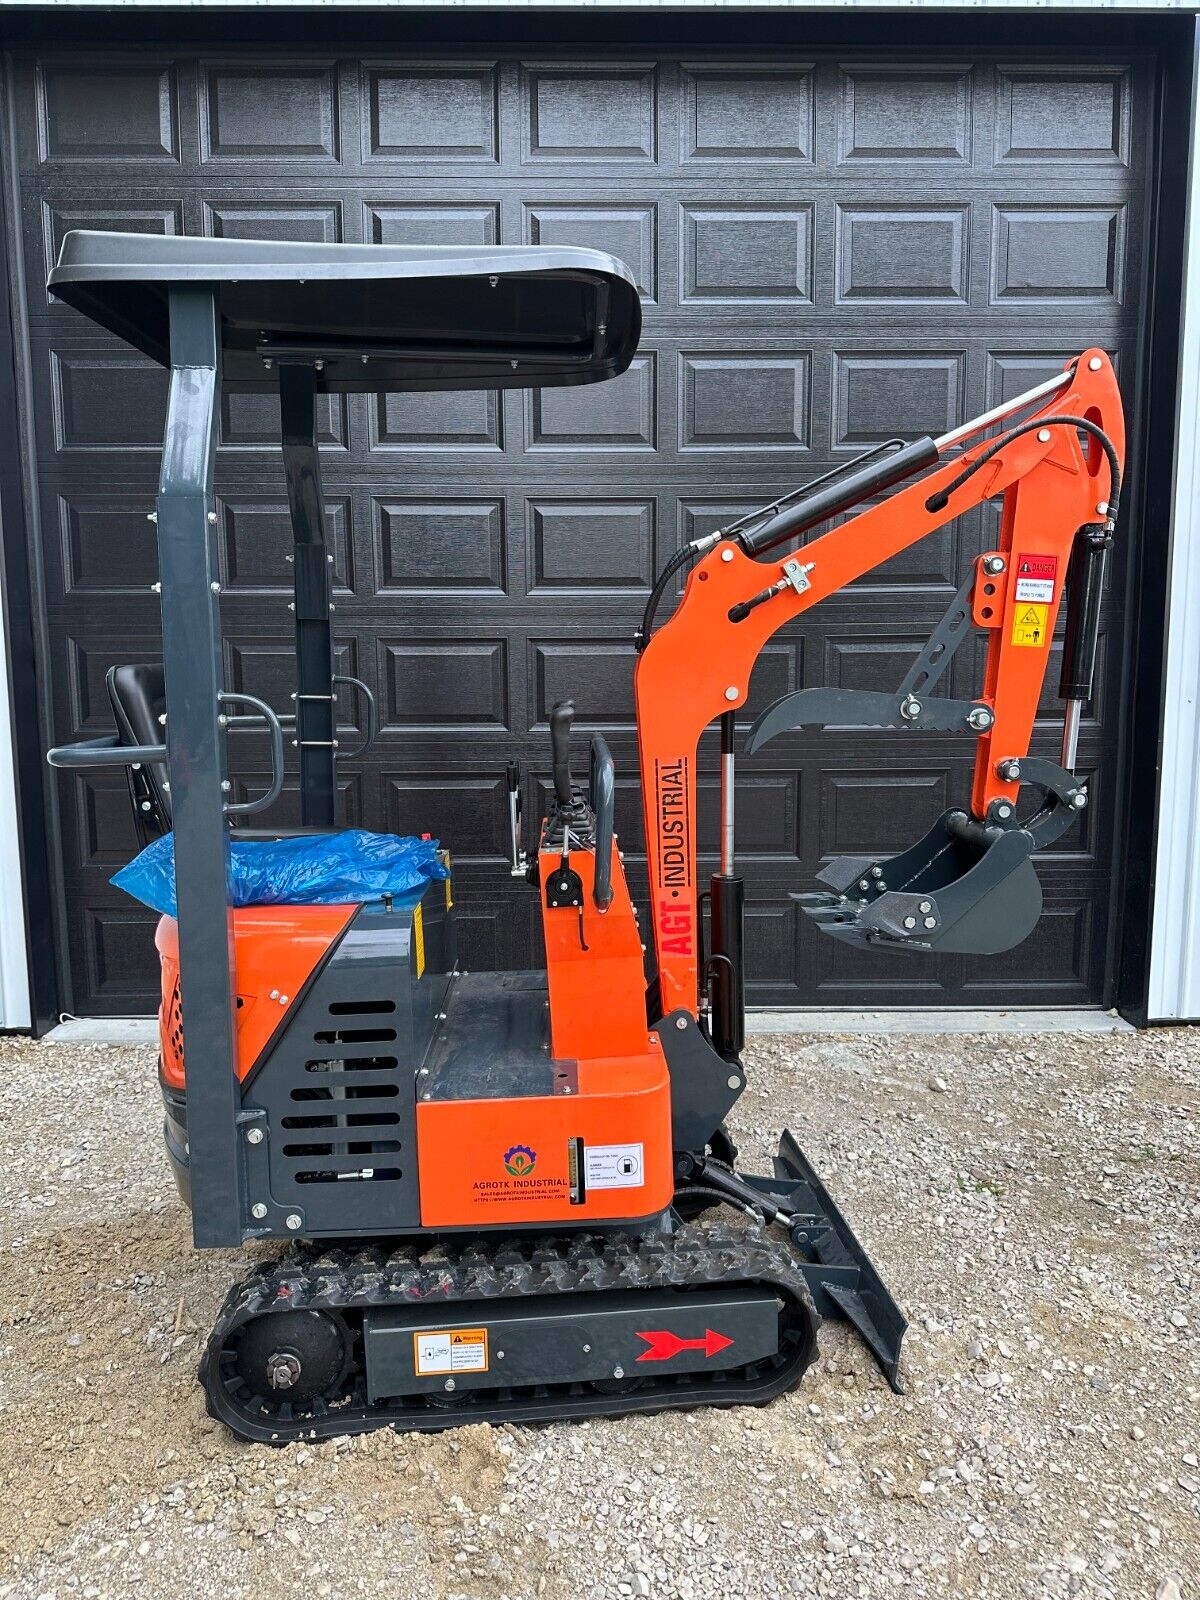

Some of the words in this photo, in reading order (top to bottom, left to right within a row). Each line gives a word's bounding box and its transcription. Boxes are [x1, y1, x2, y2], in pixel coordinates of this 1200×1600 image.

[1032, 563, 1055, 573] DANGER
[661, 758, 685, 888] INDUSTRIAL
[660, 901, 692, 956] AGT
[473, 1181, 510, 1190] AGROTK
[513, 1179, 567, 1188] INDUSTRIAL
